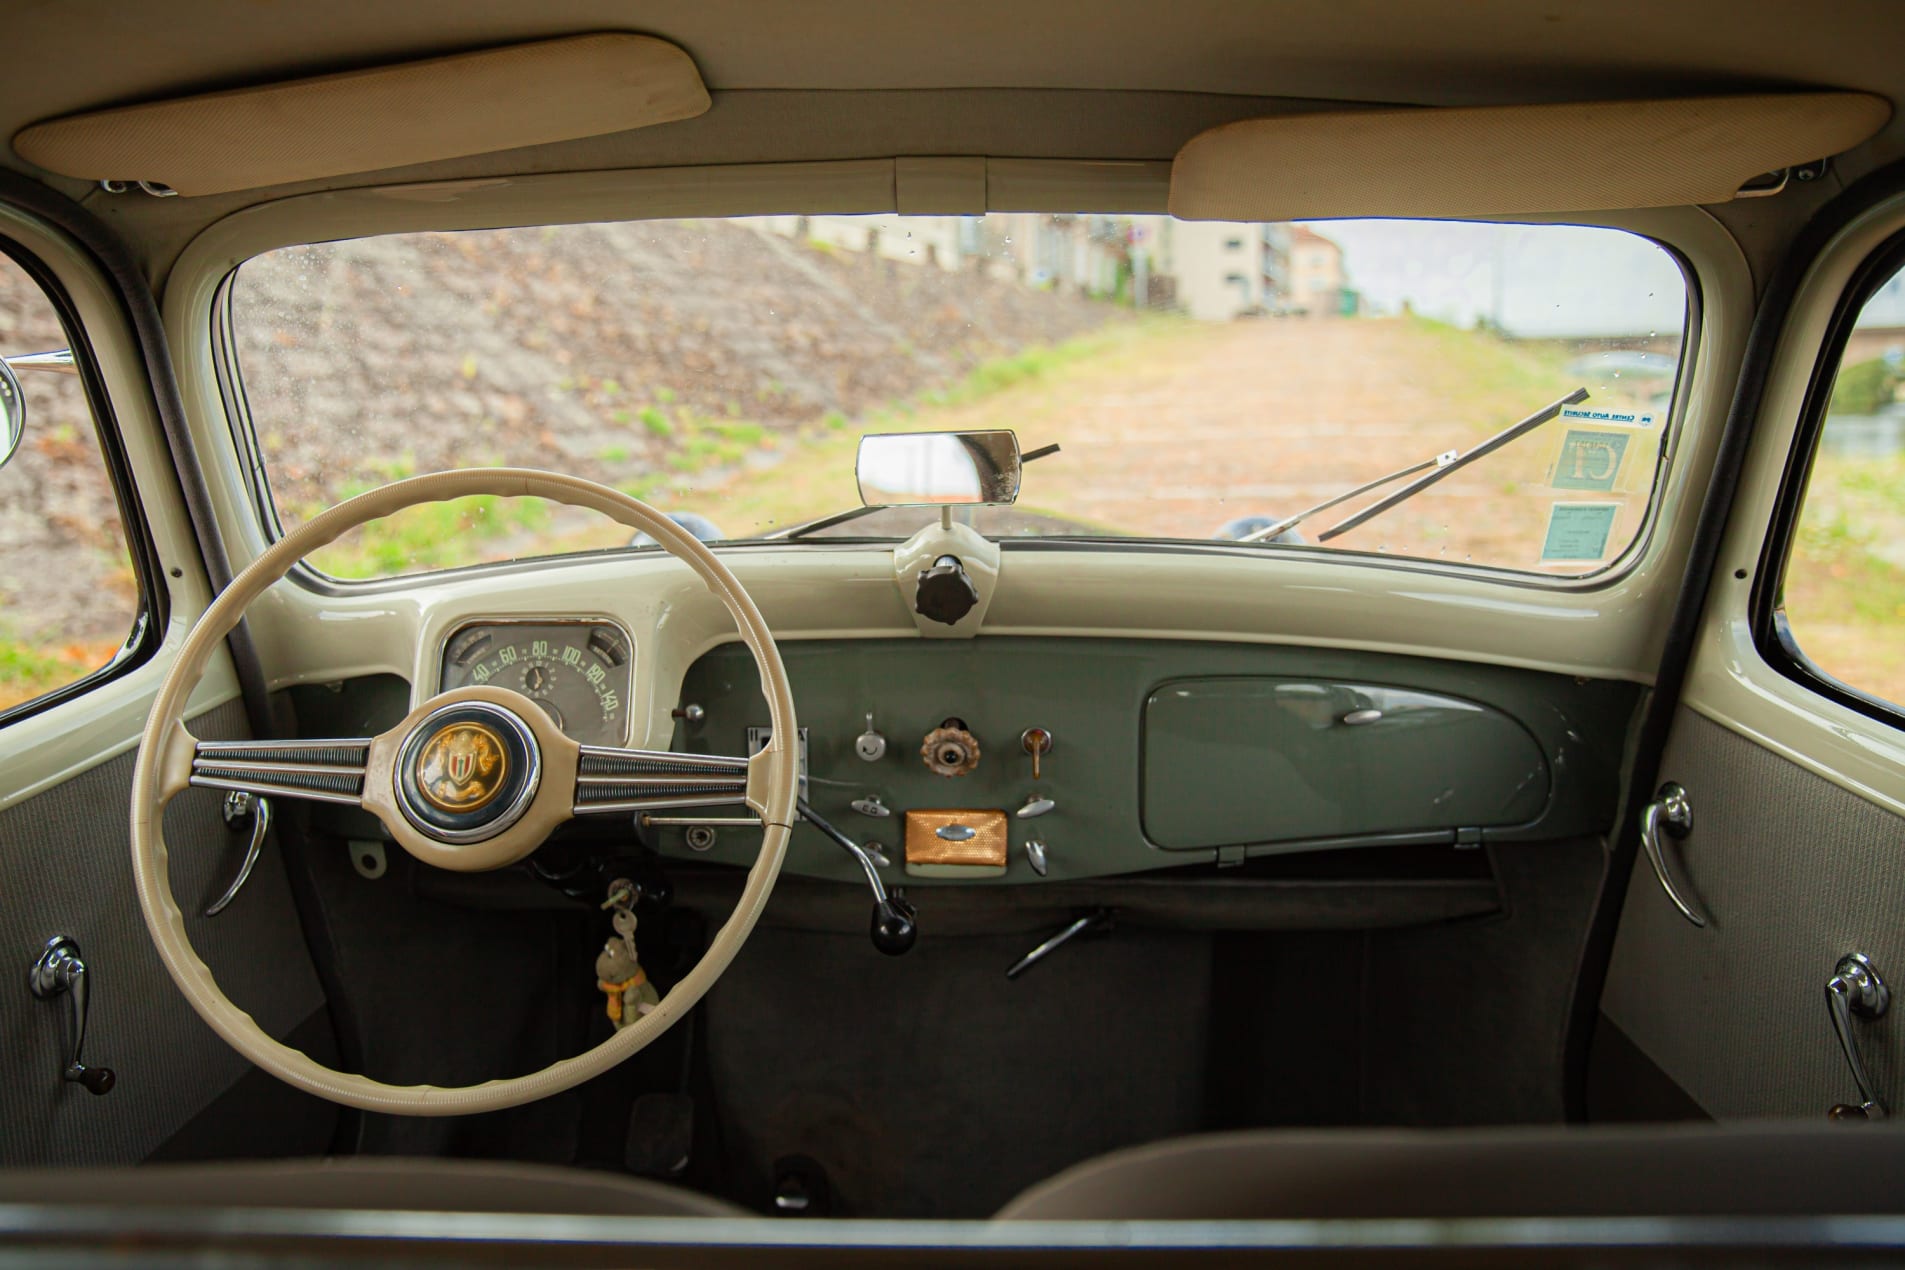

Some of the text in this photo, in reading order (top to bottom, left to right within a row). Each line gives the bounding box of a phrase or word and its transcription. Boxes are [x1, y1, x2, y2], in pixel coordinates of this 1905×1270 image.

[498, 645, 518, 664] 60
[532, 640, 548, 656] 80
[561, 645, 582, 665] 100
[472, 662, 490, 682] 40
[586, 663, 606, 685] 120
[601, 689, 619, 711] 140
